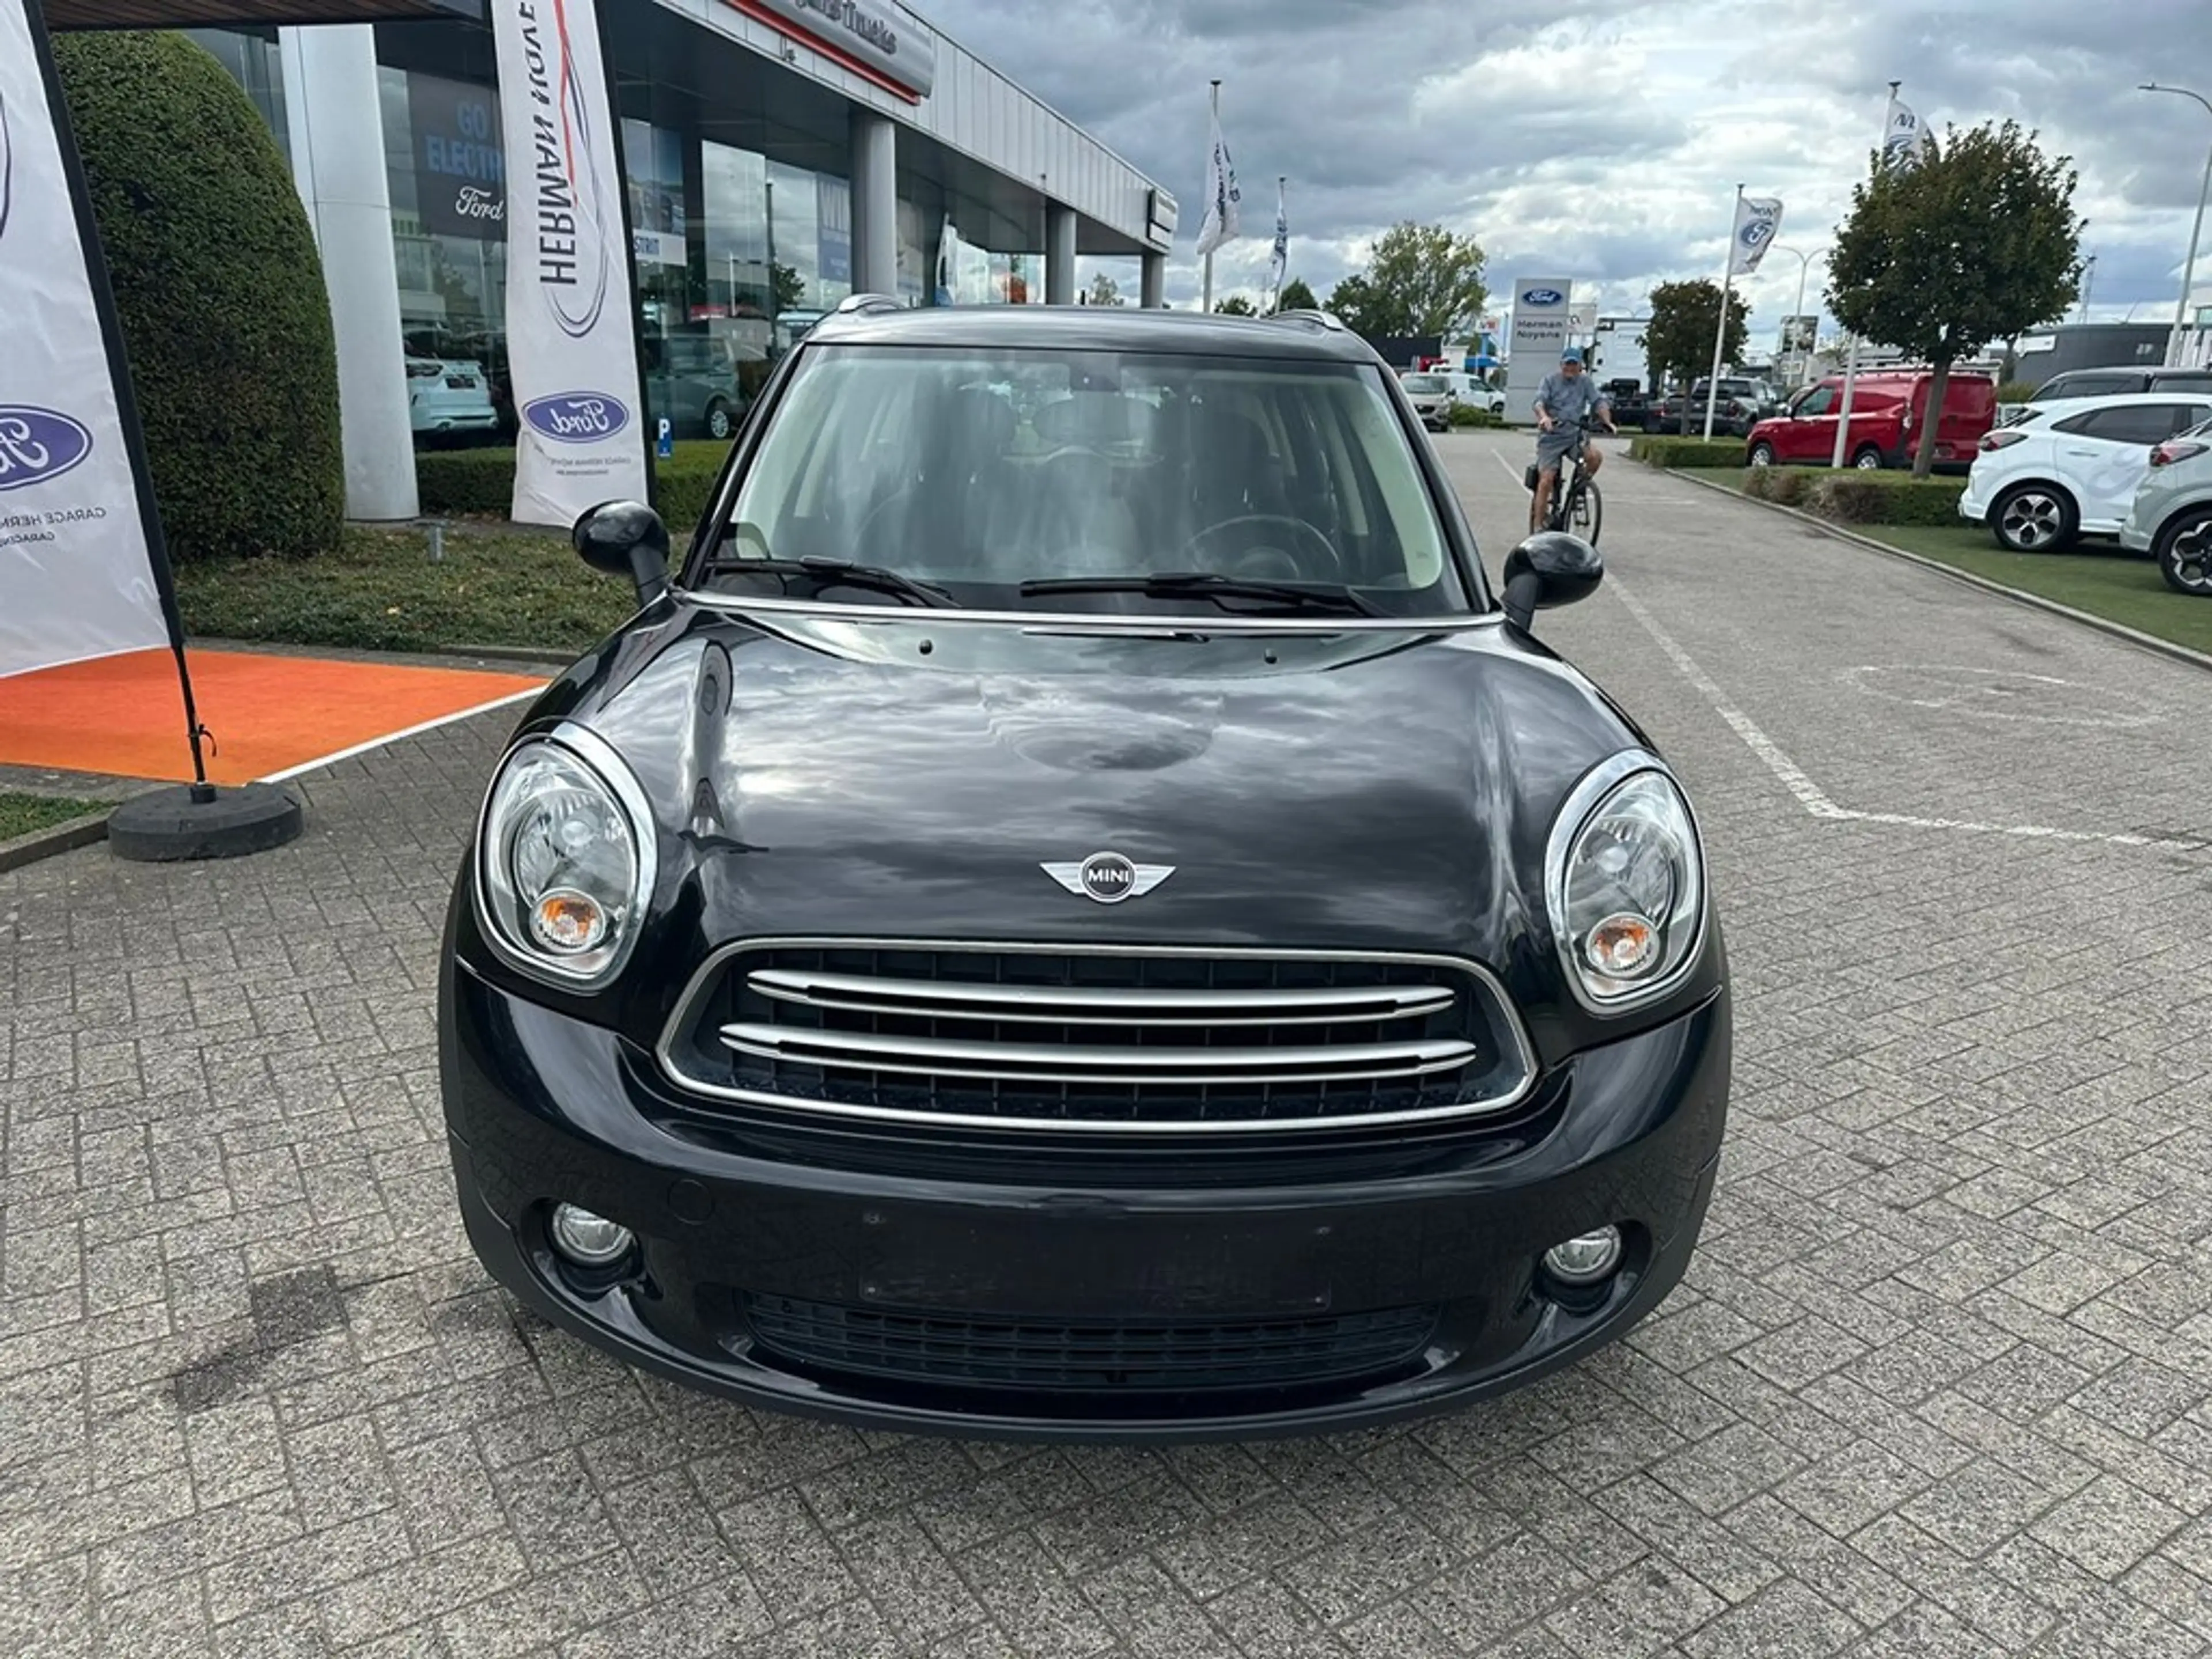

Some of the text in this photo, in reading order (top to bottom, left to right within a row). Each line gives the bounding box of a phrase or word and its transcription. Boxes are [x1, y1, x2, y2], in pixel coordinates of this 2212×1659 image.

[457, 101, 488, 139] GO
[456, 185, 505, 221] Ford
[1528, 291, 1556, 302] Ford
[1517, 320, 1563, 328] Herman
[658, 419, 671, 440] P
[1088, 868, 1129, 882] MINI
